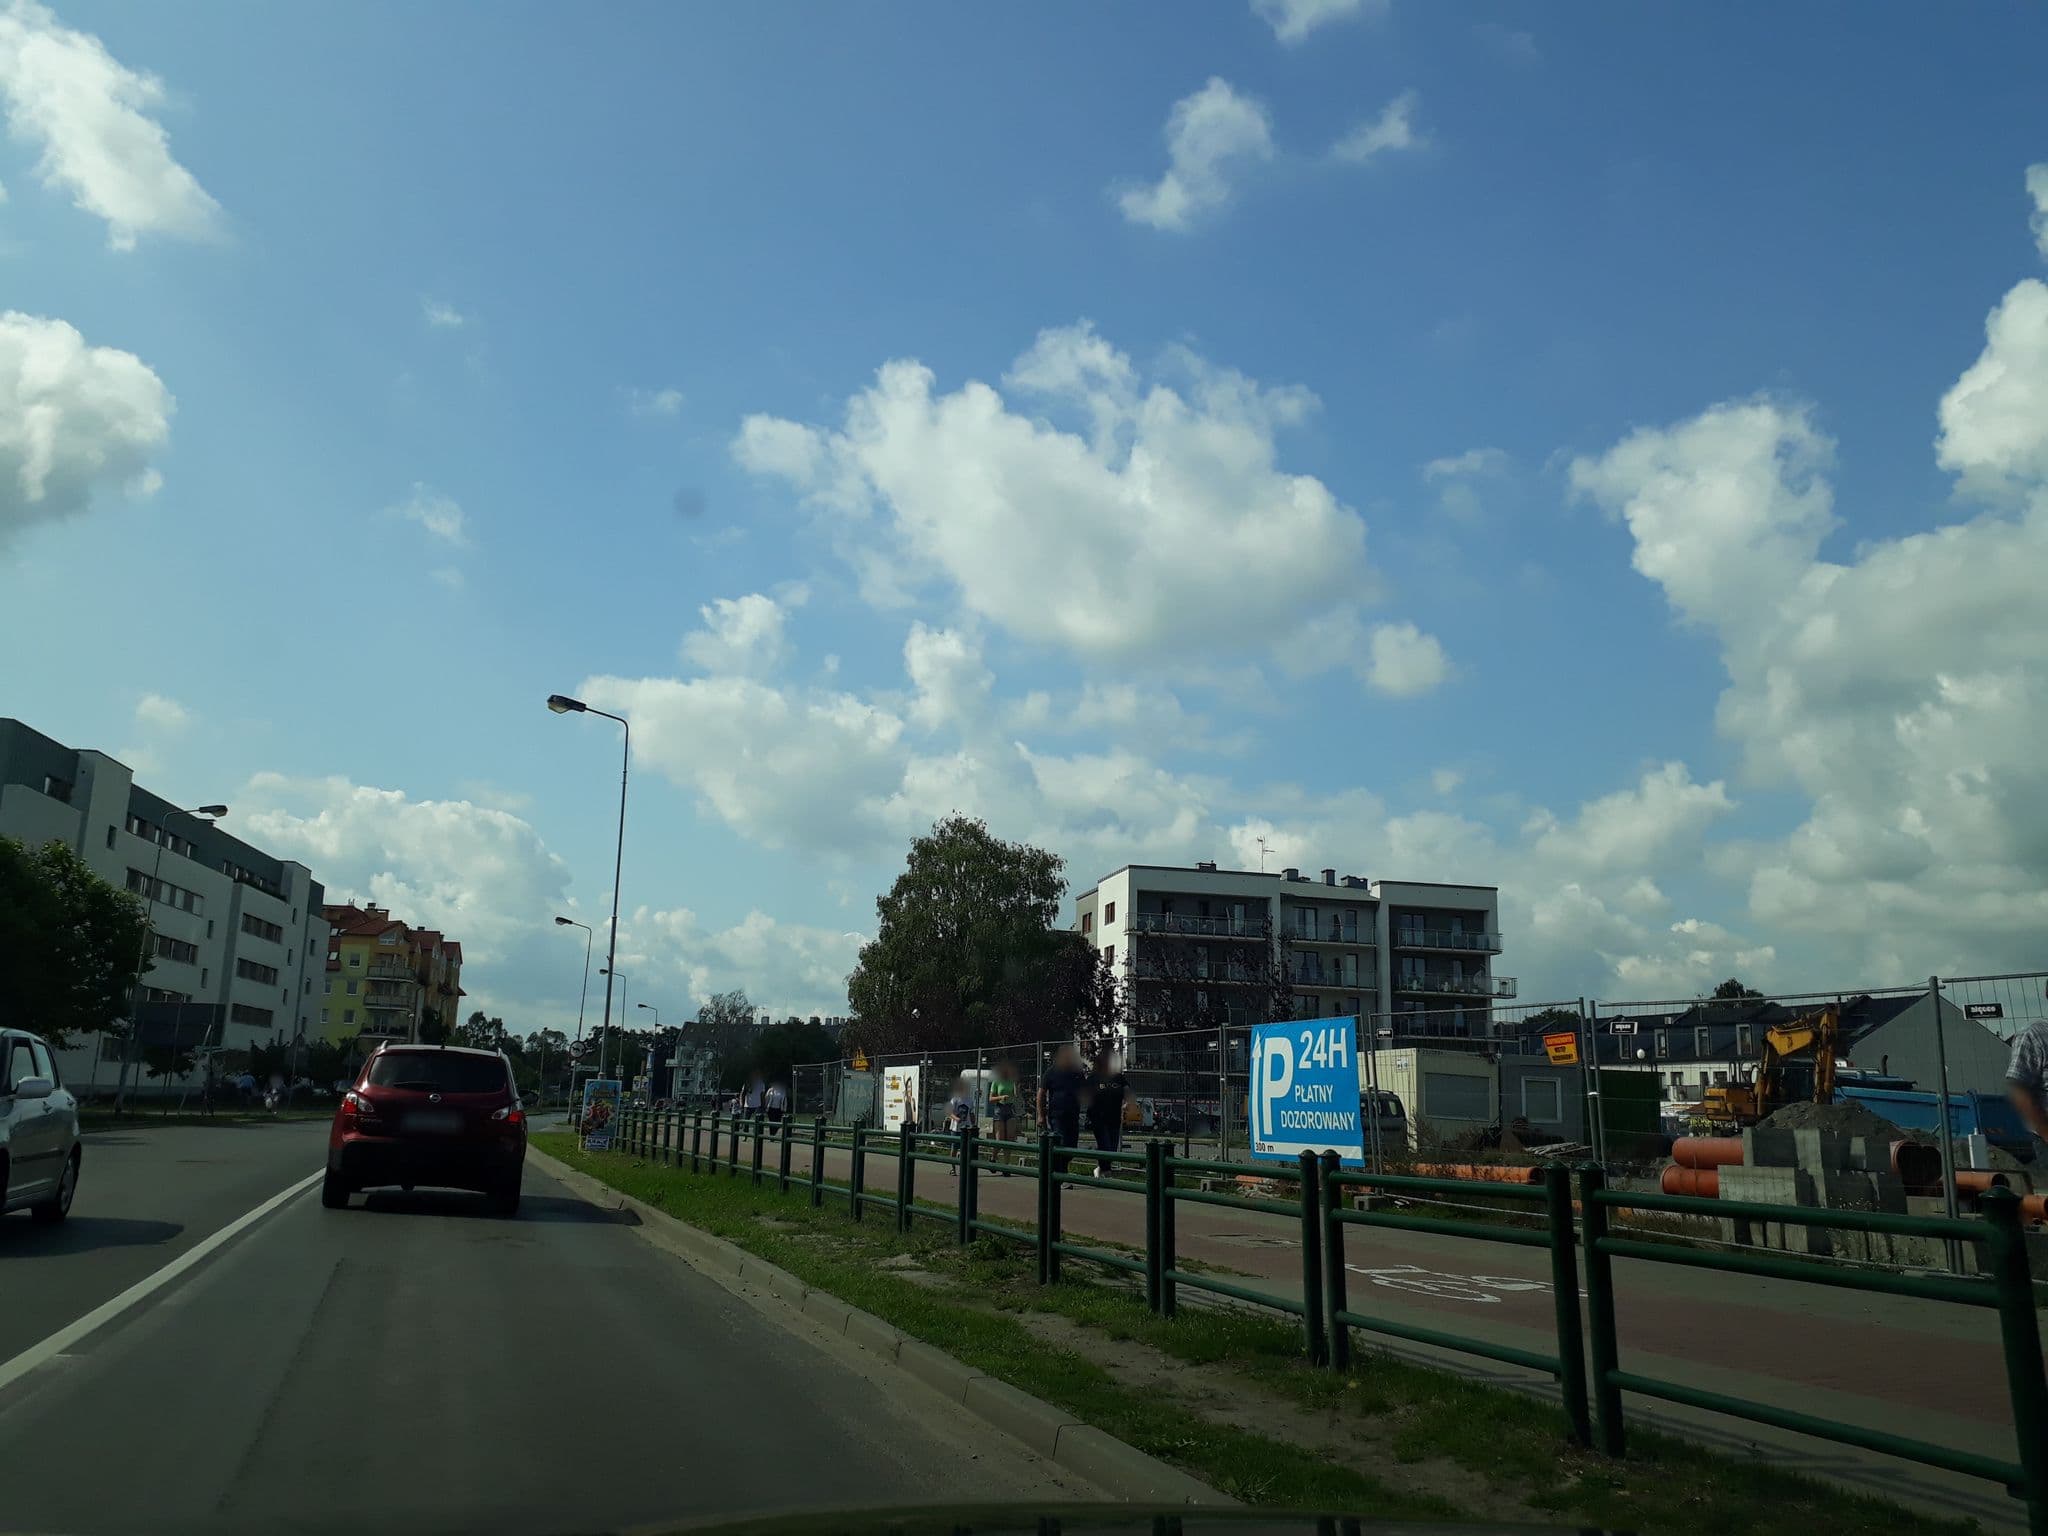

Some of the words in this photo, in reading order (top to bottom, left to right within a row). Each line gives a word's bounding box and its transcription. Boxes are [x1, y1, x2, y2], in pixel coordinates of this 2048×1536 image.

[1298, 1027, 1348, 1069] 24H
[1262, 1036, 1294, 1135] P
[1294, 1084, 1333, 1103] PŁATNY
[1280, 1110, 1355, 1131] DOZOROWANY
